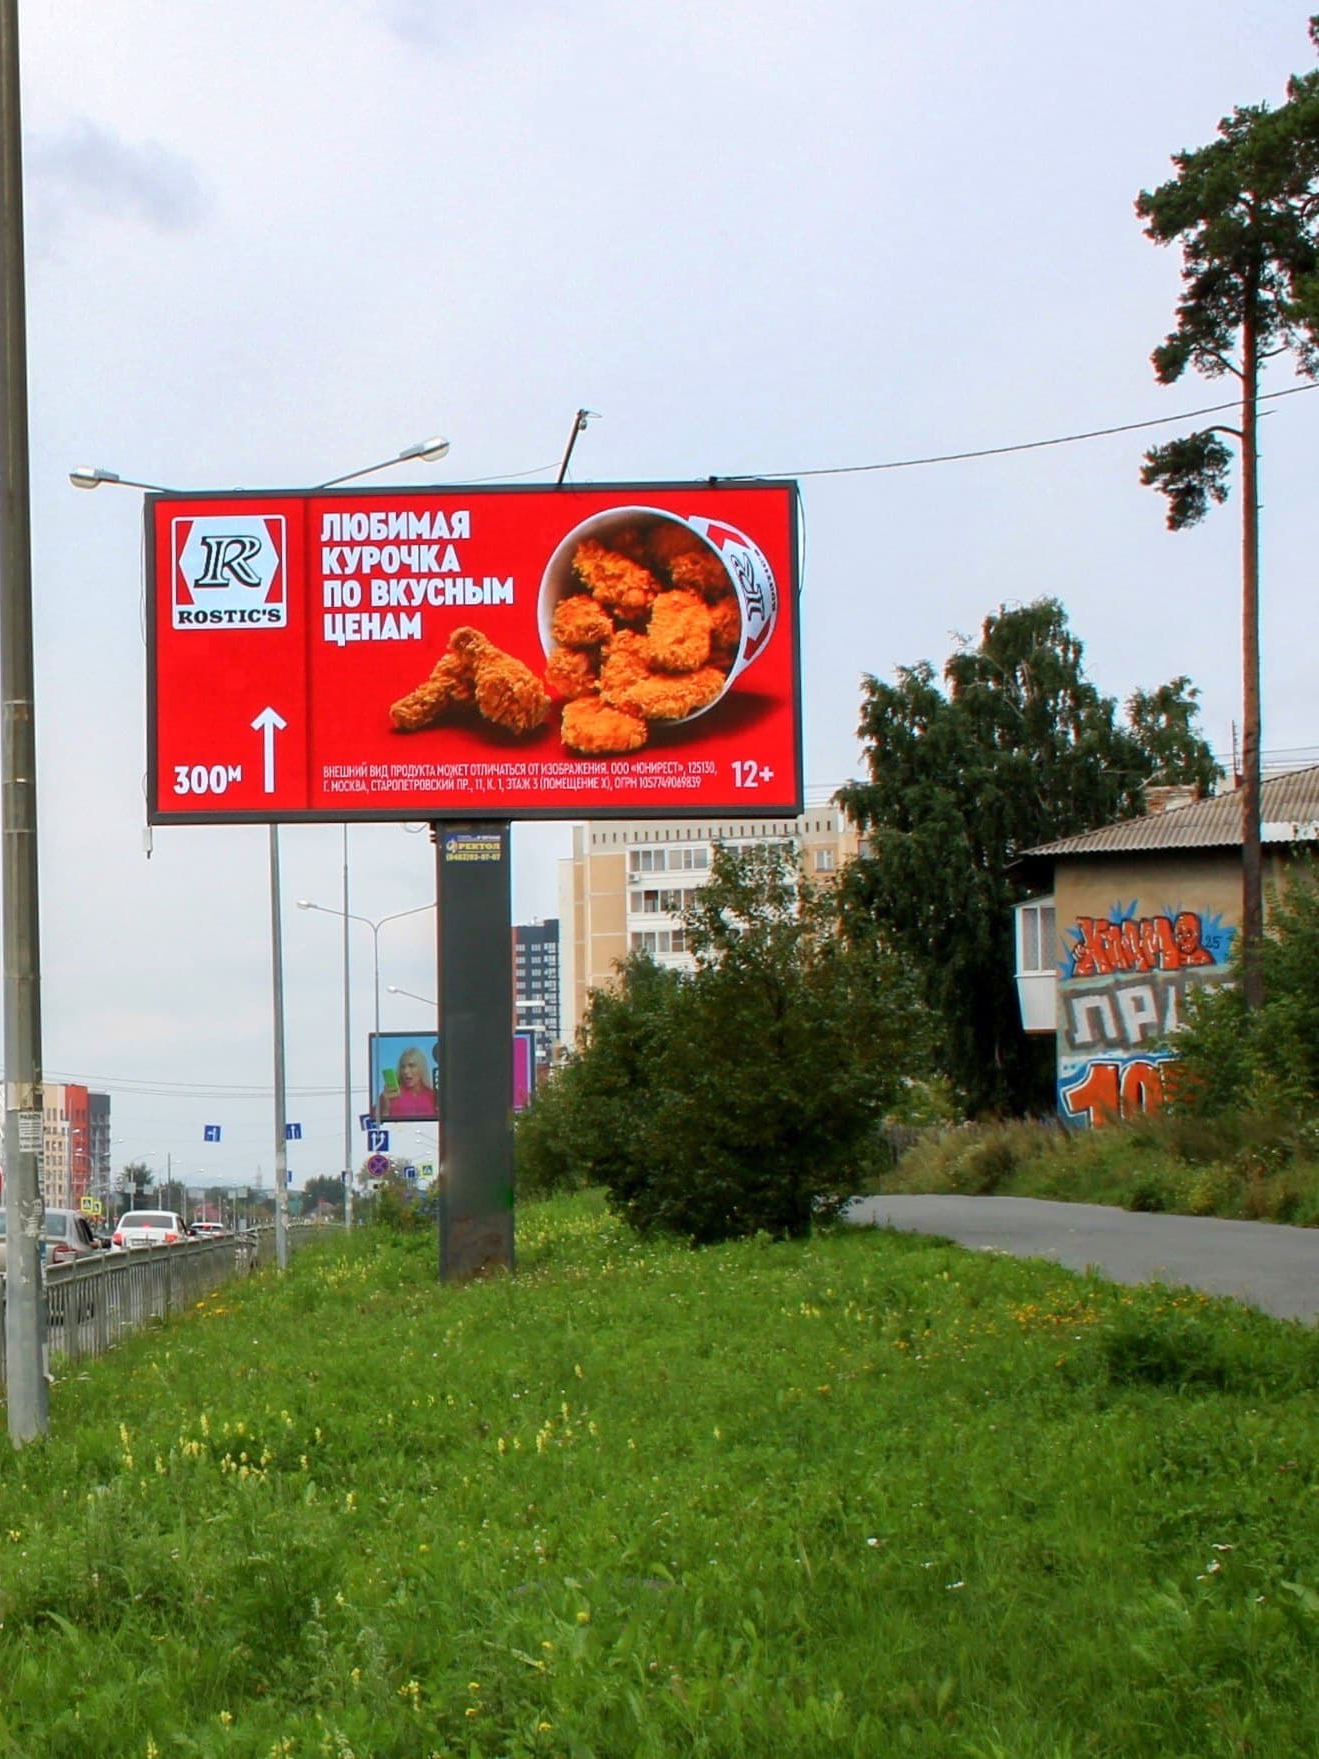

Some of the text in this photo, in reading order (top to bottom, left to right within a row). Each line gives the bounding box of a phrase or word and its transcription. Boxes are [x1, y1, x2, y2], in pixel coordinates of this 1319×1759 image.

[321, 510, 470, 541] ЛЮБИМАЯ
[193, 535, 262, 588] R
[322, 544, 461, 575] КУРОЧКА
[323, 577, 513, 608] ПО ВКУСНЫМ
[178, 609, 281, 624] ROSTIC'S
[324, 612, 421, 646] ЦЕНАМ
[323, 762, 368, 778] ВНЕШНИЙ
[369, 765, 389, 779] ВИД
[390, 765, 437, 779] ПРОДУКТА
[437, 764, 469, 777] МОЖЕТ
[470, 763, 526, 777] ОТЛИЧАТЬСЯ
[528, 764, 541, 775] ОТ
[541, 763, 609, 776] ИЗОБРАЖЕНИЯ.
[611, 762, 630, 775] ООО
[688, 761, 718, 775] 125130,
[324, 780, 331, 792] Г.
[331, 780, 370, 793] МОСКВА,
[371, 777, 455, 792] СТАРОПЕТРОВСКИЙ
[506, 777, 532, 790] ЭТАЖ
[533, 777, 539, 789] 3
[540, 776, 599, 790] (ПОМЕЩЕНИЕ
[614, 777, 638, 789] ОГРН
[731, 760, 774, 787] 12+
[1205, 935, 1221, 949] 25
